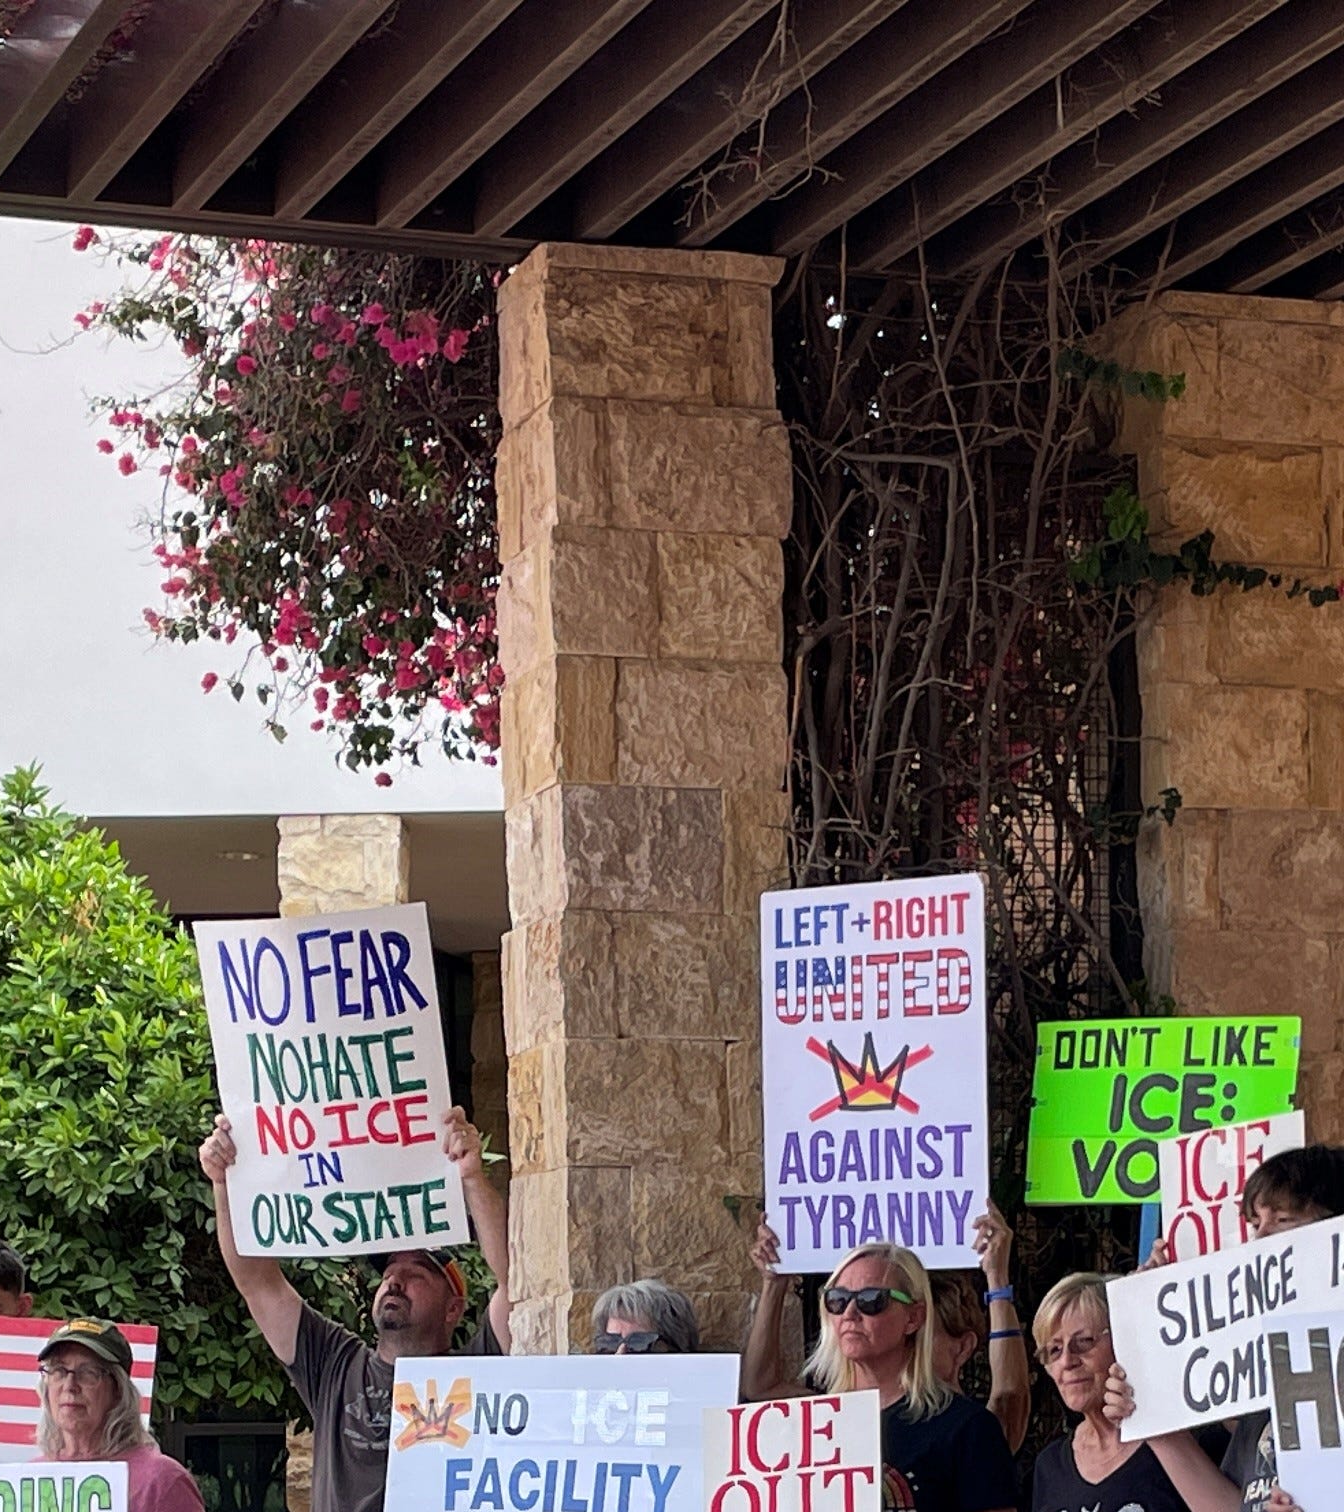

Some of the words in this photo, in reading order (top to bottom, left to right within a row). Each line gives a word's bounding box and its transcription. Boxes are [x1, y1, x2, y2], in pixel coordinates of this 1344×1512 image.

[218, 936, 291, 1026] NO
[298, 929, 429, 1023] FEAR
[774, 947, 973, 1025] UNITED
[1054, 1026, 1161, 1070] DON'T
[1183, 1025, 1278, 1067] LIKE
[256, 1103, 316, 1155] NO
[324, 1095, 436, 1147] ICE
[1109, 1073, 1238, 1134] ICE:
[298, 1151, 344, 1188] IN
[778, 1124, 973, 1185] AGAINST
[252, 1193, 328, 1247] OUR
[323, 1178, 449, 1243] STATE
[778, 1190, 974, 1251] TYRANNY
[1157, 1246, 1297, 1347] SILENCE
[473, 1393, 529, 1436] NO
[571, 1389, 669, 1447] ICE
[727, 1397, 842, 1477] ICE
